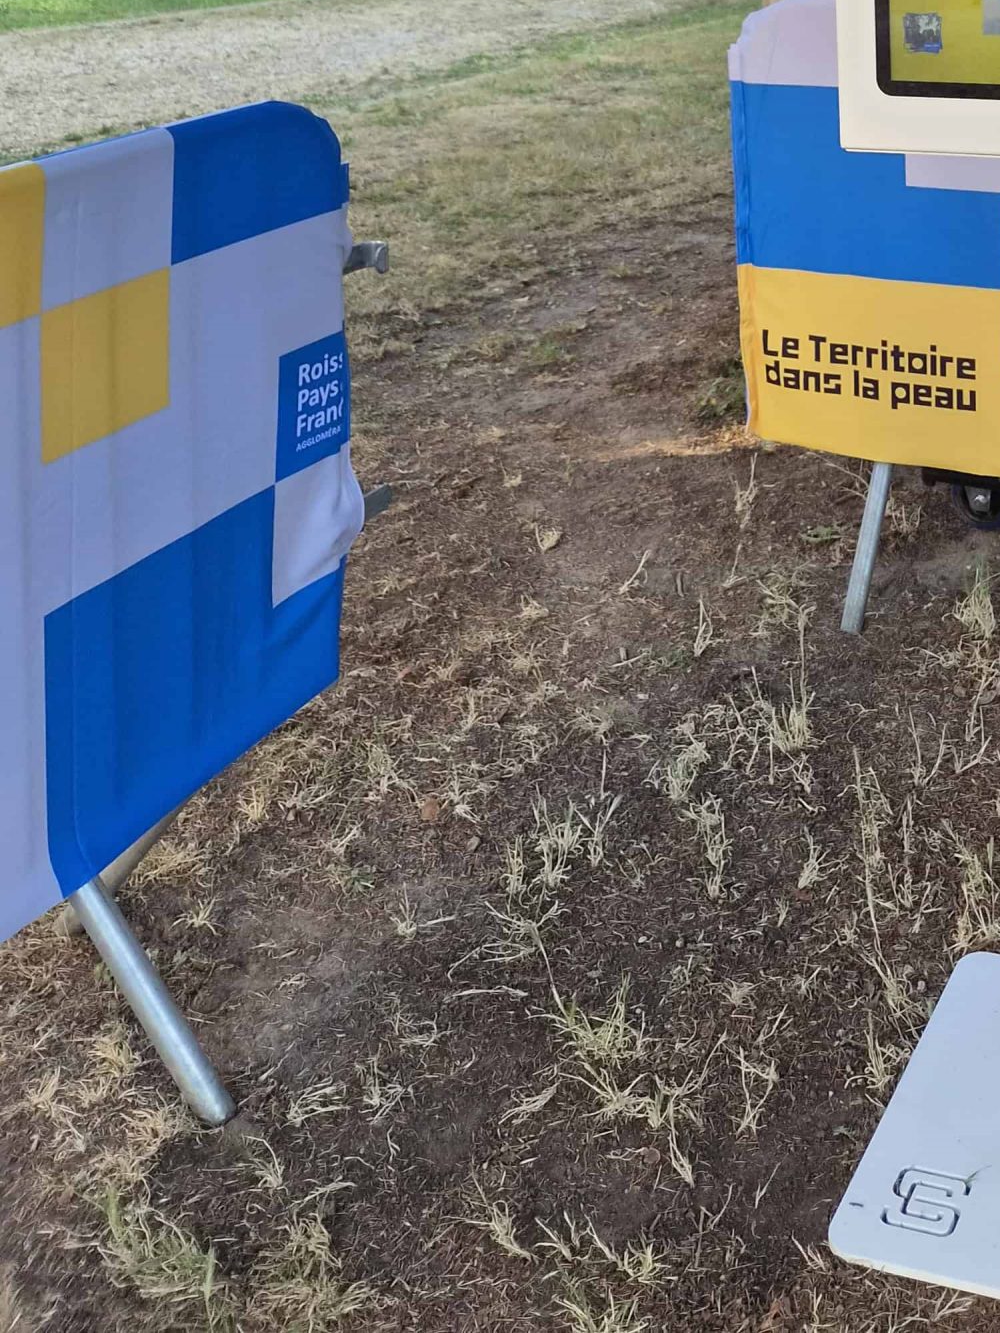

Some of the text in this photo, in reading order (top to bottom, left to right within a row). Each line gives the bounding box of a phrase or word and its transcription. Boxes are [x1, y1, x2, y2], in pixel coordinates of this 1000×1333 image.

[762, 329, 976, 380] Le Territoire
[297, 379, 339, 413] Pays
[765, 360, 977, 412] dans la peau
[295, 424, 342, 452] AGGLOMÉRA
